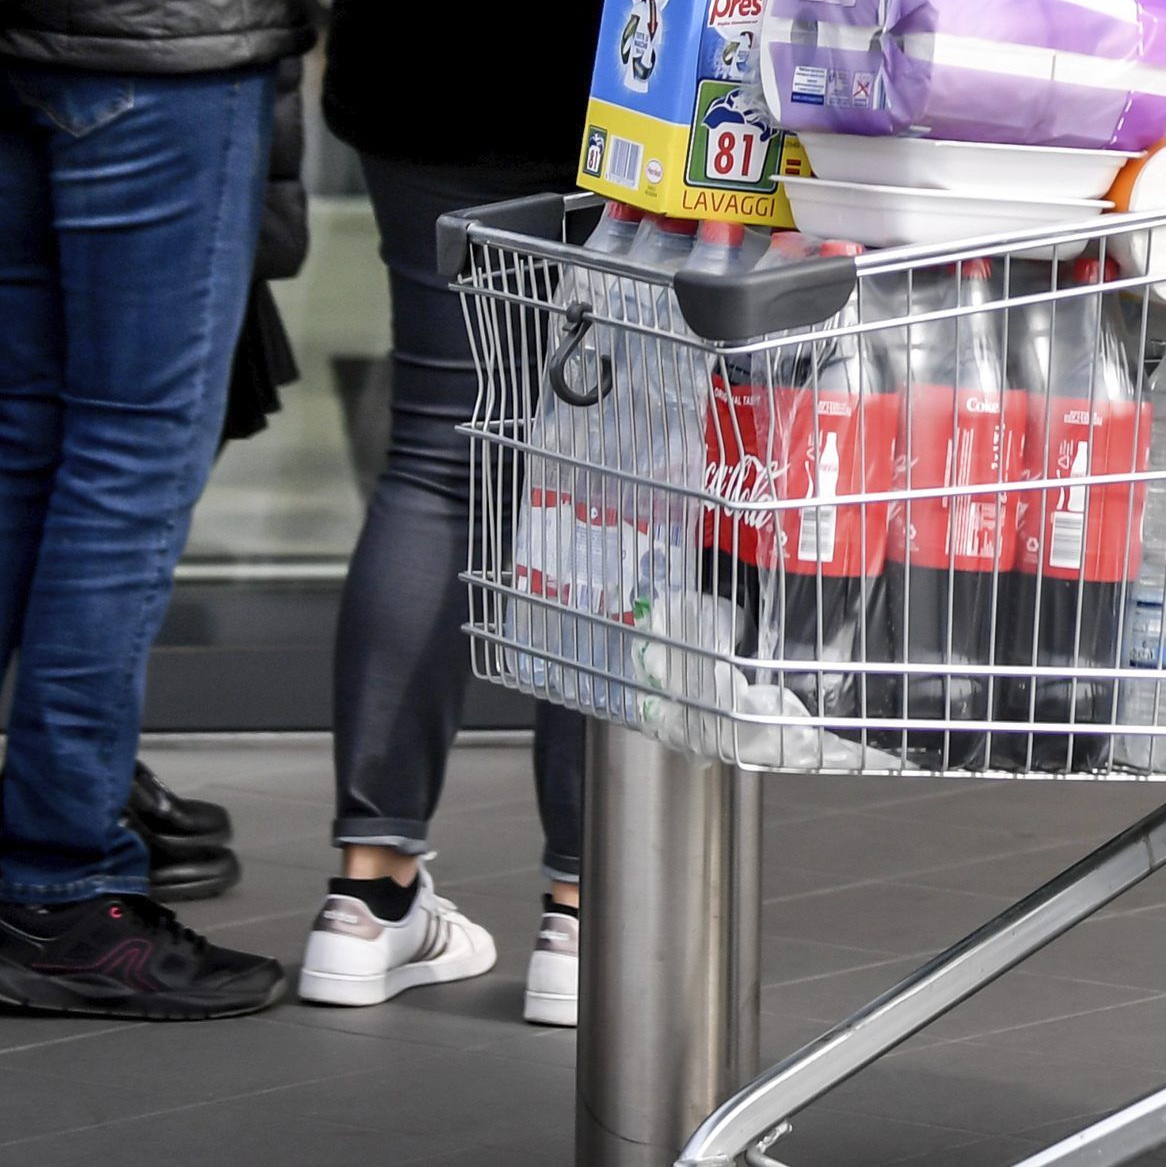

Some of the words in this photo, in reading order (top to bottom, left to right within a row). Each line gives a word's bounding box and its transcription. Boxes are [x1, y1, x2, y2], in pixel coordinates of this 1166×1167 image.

[588, 149, 599, 171] 81
[714, 130, 754, 177] 81
[682, 189, 776, 218] LAVAGGI
